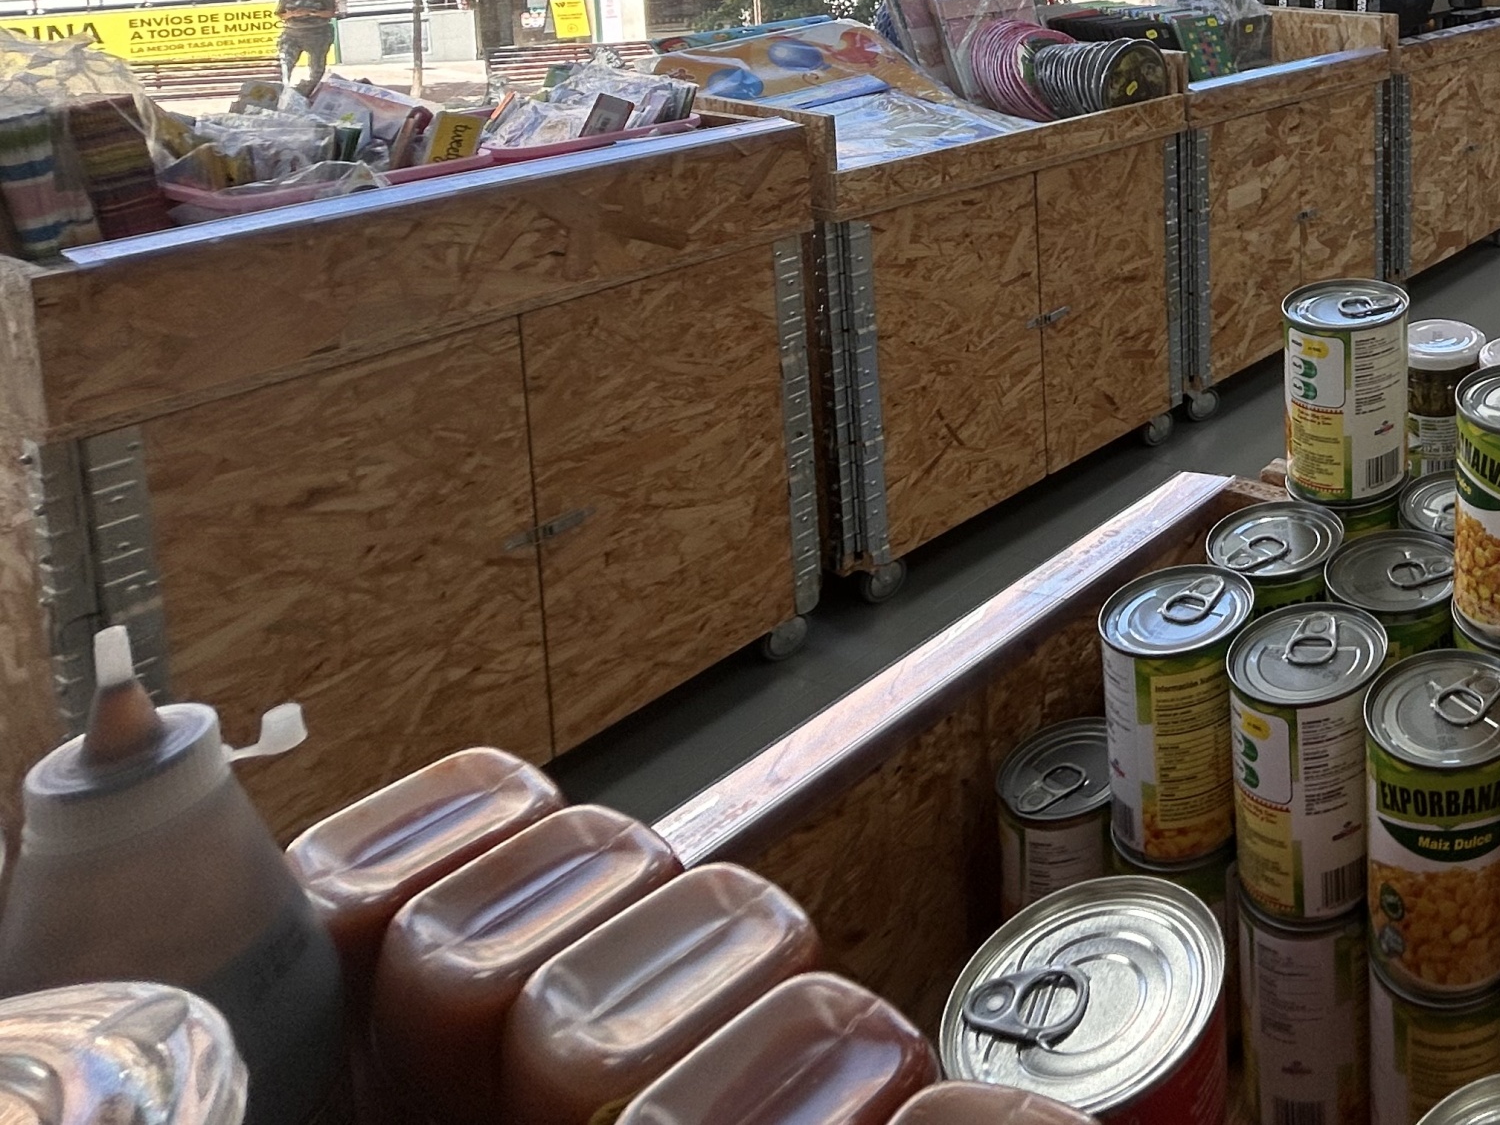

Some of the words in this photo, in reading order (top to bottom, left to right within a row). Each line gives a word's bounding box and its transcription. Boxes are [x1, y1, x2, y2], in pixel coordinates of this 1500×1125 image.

[129, 13, 193, 29] ENVÍOS
[198, 13, 220, 23] DE
[130, 30, 144, 41] A
[149, 27, 196, 40] TODO
[201, 25, 221, 36] EL
[130, 46, 144, 55] LA
[147, 43, 185, 53] MEJOR
[187, 41, 213, 50] TASA
[216, 39, 236, 48] DEL
[1453, 832, 1493, 851] Dulce
